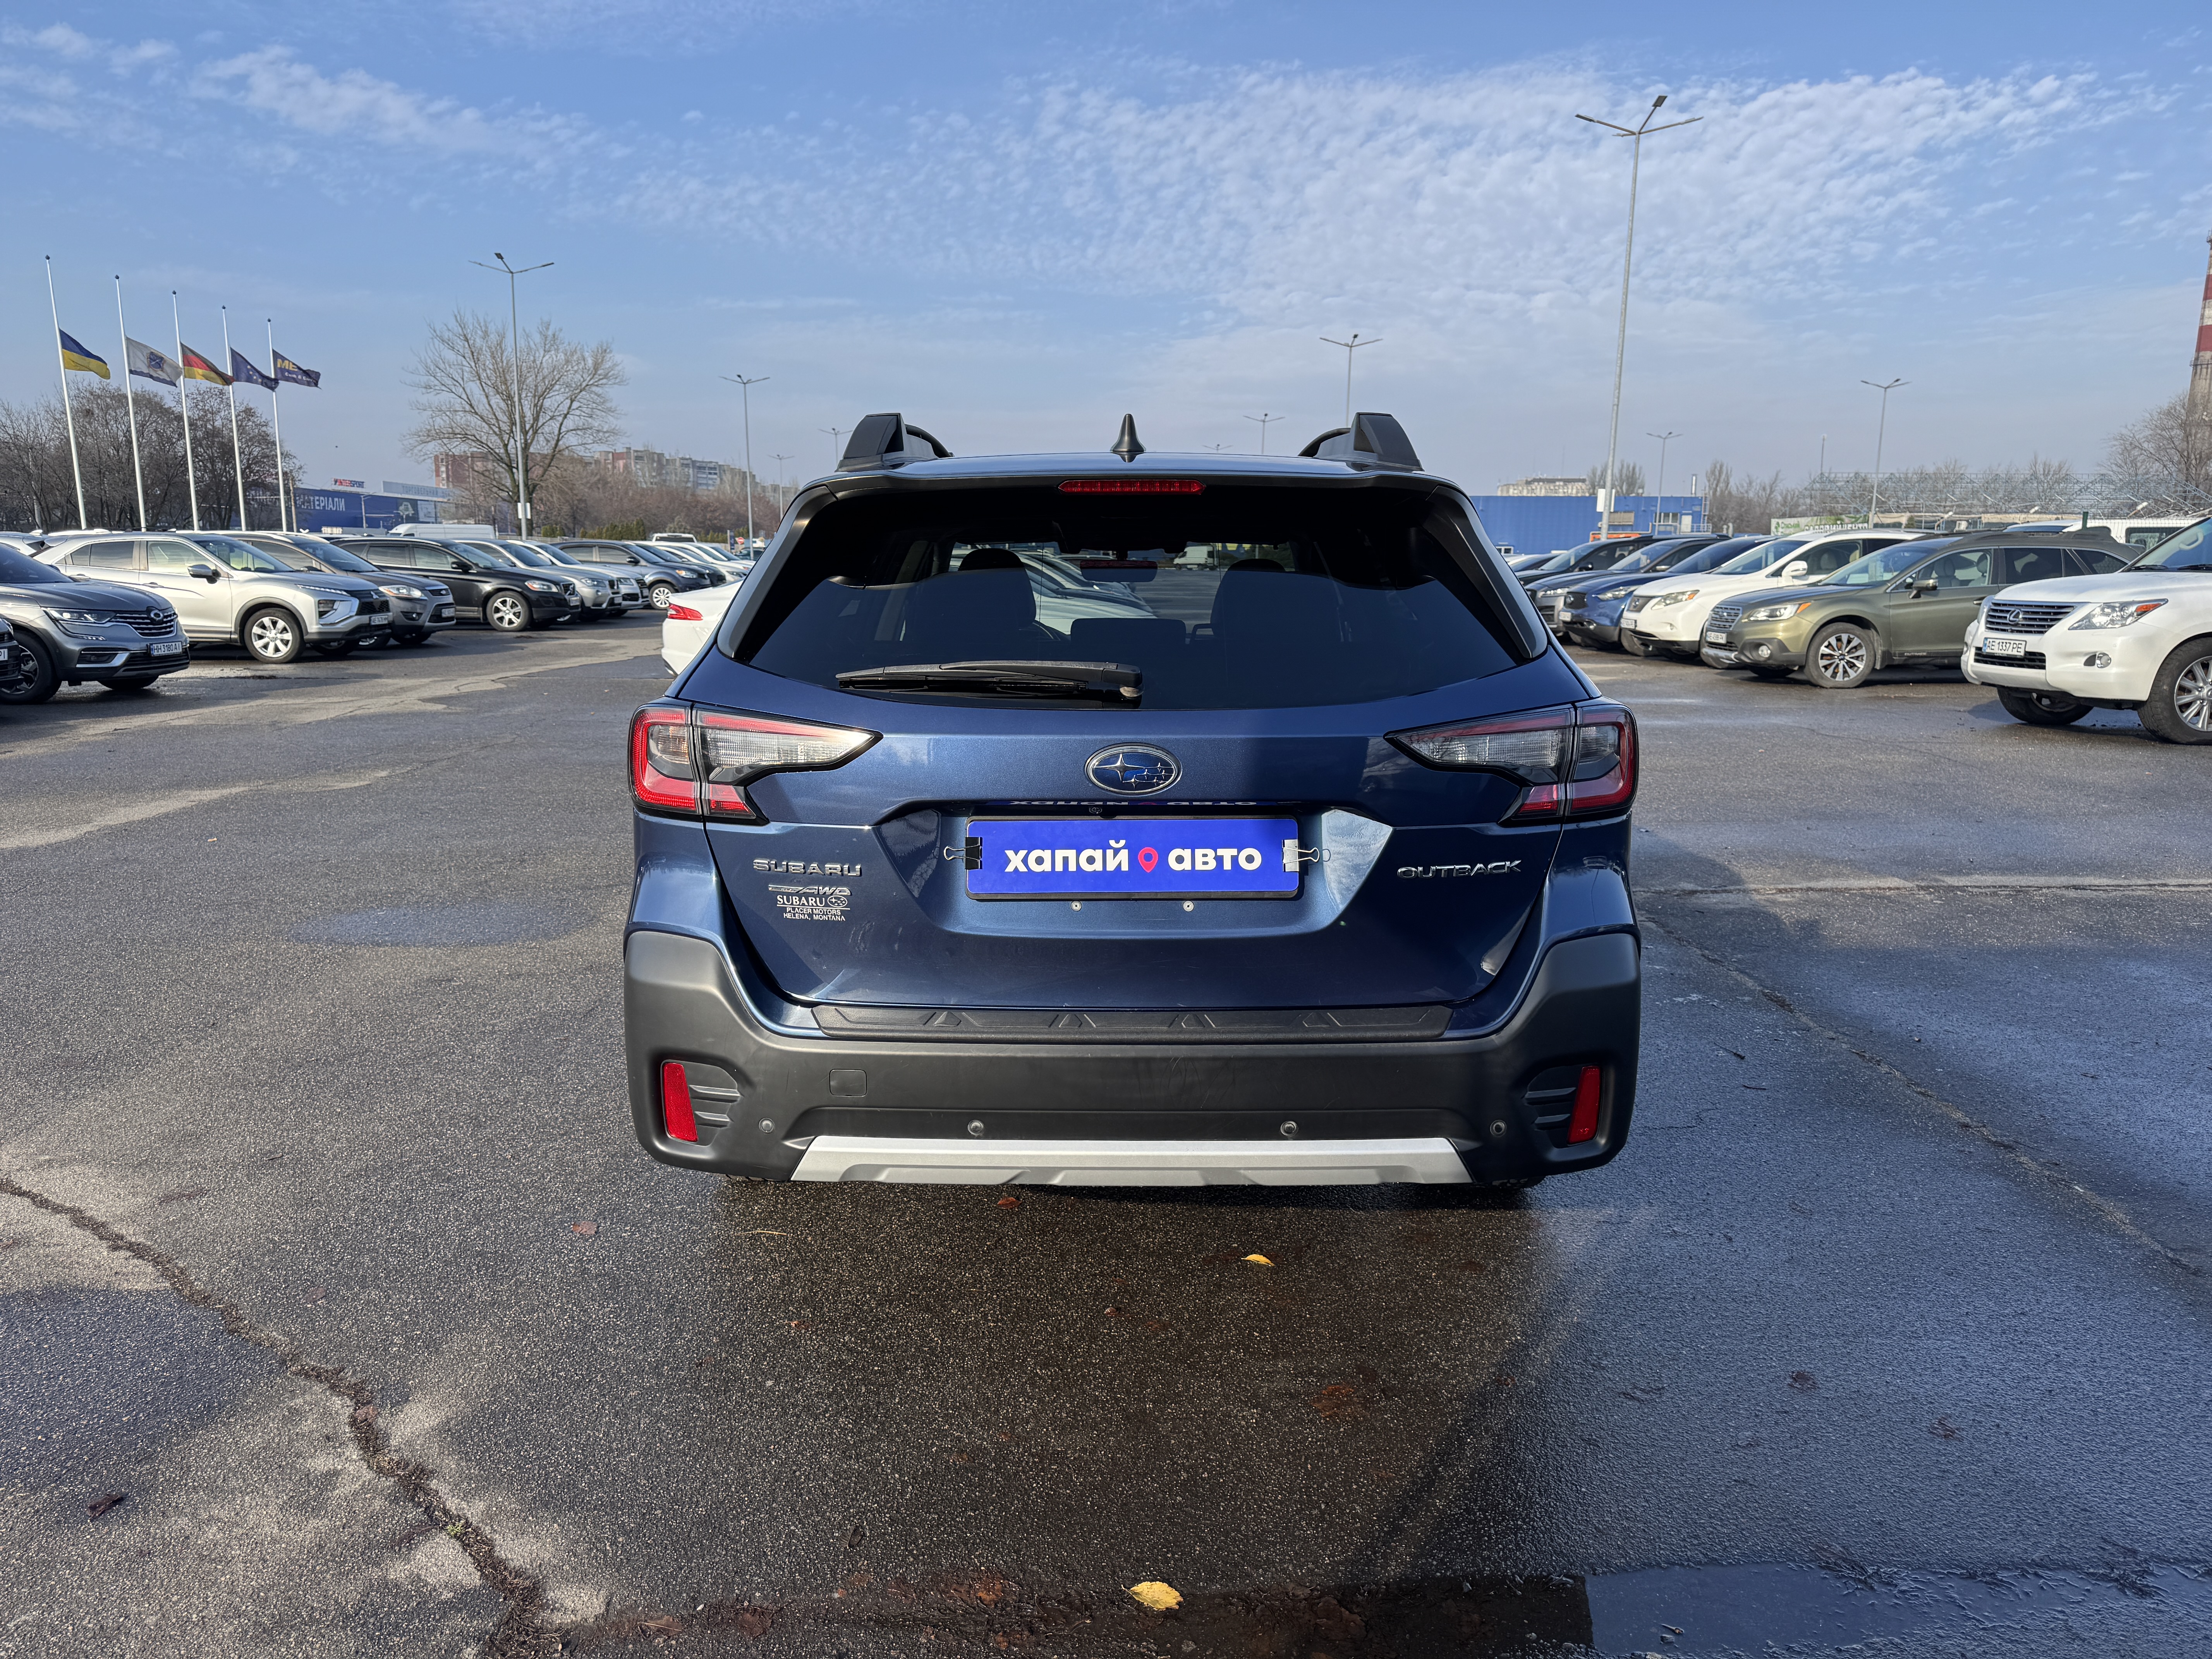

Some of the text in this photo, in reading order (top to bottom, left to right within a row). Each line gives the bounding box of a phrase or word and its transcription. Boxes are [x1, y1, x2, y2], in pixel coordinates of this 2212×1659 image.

[1987, 641, 2023, 653] AE 1337 PE
[1004, 839, 1262, 872] хапай авто
[753, 859, 862, 877] SUBARU
[1397, 859, 1522, 879] OUTBACK
[799, 886, 851, 896] AWD
[777, 895, 825, 907] SUBARU
